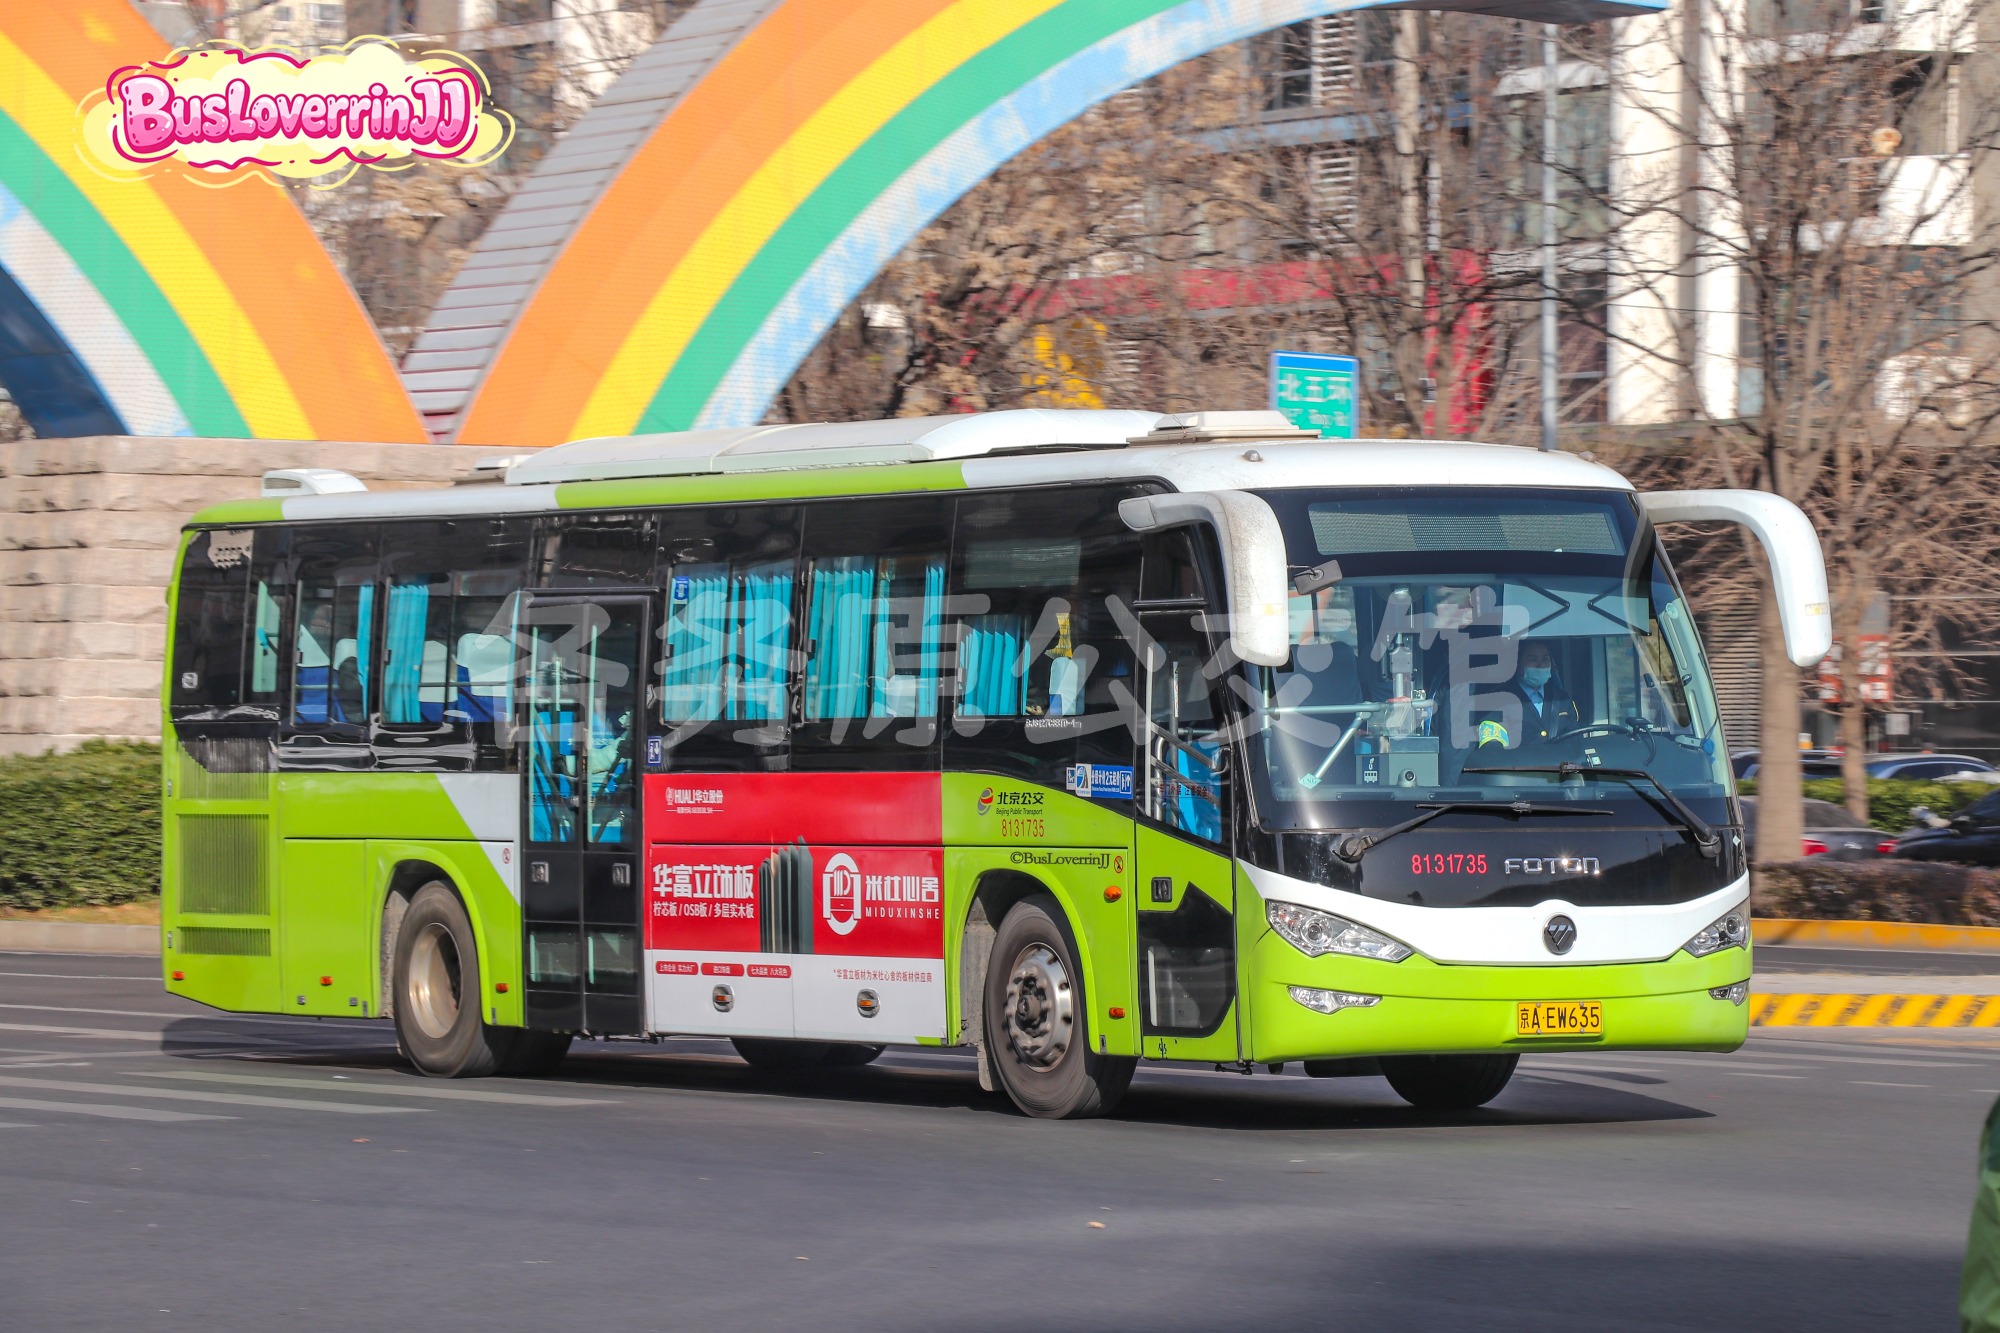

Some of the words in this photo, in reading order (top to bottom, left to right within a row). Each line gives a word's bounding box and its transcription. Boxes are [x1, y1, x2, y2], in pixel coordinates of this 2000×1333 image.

[997, 792, 1044, 805] 北京公交
[996, 808, 1009, 816] Beijing
[1023, 808, 1043, 816] Transport
[1002, 818, 1045, 837] 8131735
[1411, 853, 1488, 875] 8131735
[1504, 856, 1600, 875] FOTON
[653, 863, 754, 899] 华富立饰板
[865, 875, 939, 903] 米杜心舍
[714, 902, 754, 919] 多层实木板
[865, 907, 940, 919] MIDUXINSHE
